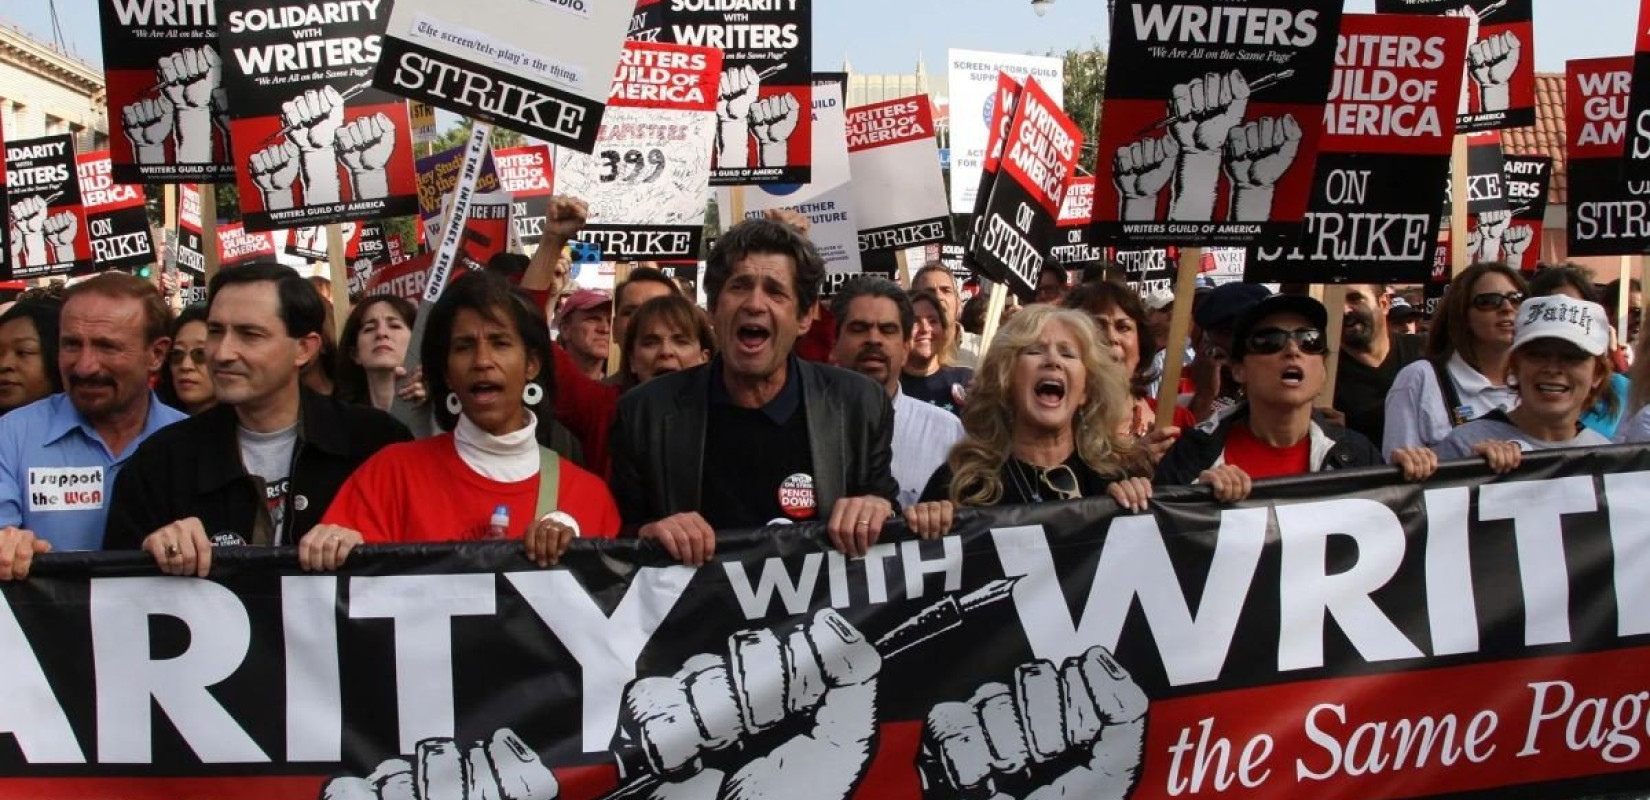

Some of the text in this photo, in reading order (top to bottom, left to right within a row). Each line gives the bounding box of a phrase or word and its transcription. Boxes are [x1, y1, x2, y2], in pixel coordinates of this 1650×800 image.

[229, 0, 381, 33] SOLIDARITY
[723, 14, 749, 22] WITH
[1131, 4, 1320, 47] WRITERS
[293, 28, 323, 38] WITH
[418, 21, 439, 38] The
[531, 58, 548, 72] the
[672, 24, 799, 50] WRITERS
[234, 35, 382, 75] WRITERS
[1169, 48, 1187, 58] Are
[1190, 48, 1204, 59] All
[1206, 51, 1218, 60] on
[1220, 49, 1234, 60] the
[1236, 50, 1264, 61] Same
[272, 76, 286, 84] Are
[287, 74, 300, 83] All
[672, 73, 700, 86] OF
[954, 61, 991, 72] SCREEN
[1031, 67, 1058, 78] GUILD
[393, 52, 587, 140] STRIKE
[1400, 80, 1438, 104] OF
[898, 115, 917, 126] OF
[1025, 92, 1074, 162] WRITERS
[1020, 120, 1068, 180] GUILD OF
[464, 157, 478, 182] THE
[600, 150, 666, 184] 399
[1009, 145, 1062, 206] AMERICA
[1326, 169, 1371, 205] ON
[270, 210, 305, 220] WRITERS
[308, 207, 332, 216] GUILD
[348, 200, 385, 211] AMERICA
[1016, 202, 1035, 234] ON
[91, 218, 112, 238] ON
[858, 221, 944, 252] STRIKE
[1068, 230, 1082, 244] ON
[1123, 225, 1262, 233] WRITERS GUILD OF AMERICA
[577, 230, 691, 255] TRIKE
[983, 213, 1044, 291] STRIKE
[428, 252, 450, 300] STUPID.
[1522, 301, 1593, 336] Faith
[30, 470, 102, 486] I support
[33, 490, 102, 506] the WGA
[722, 535, 963, 622] WITH
[1166, 716, 1273, 798] the
[1296, 703, 1499, 783] Same
